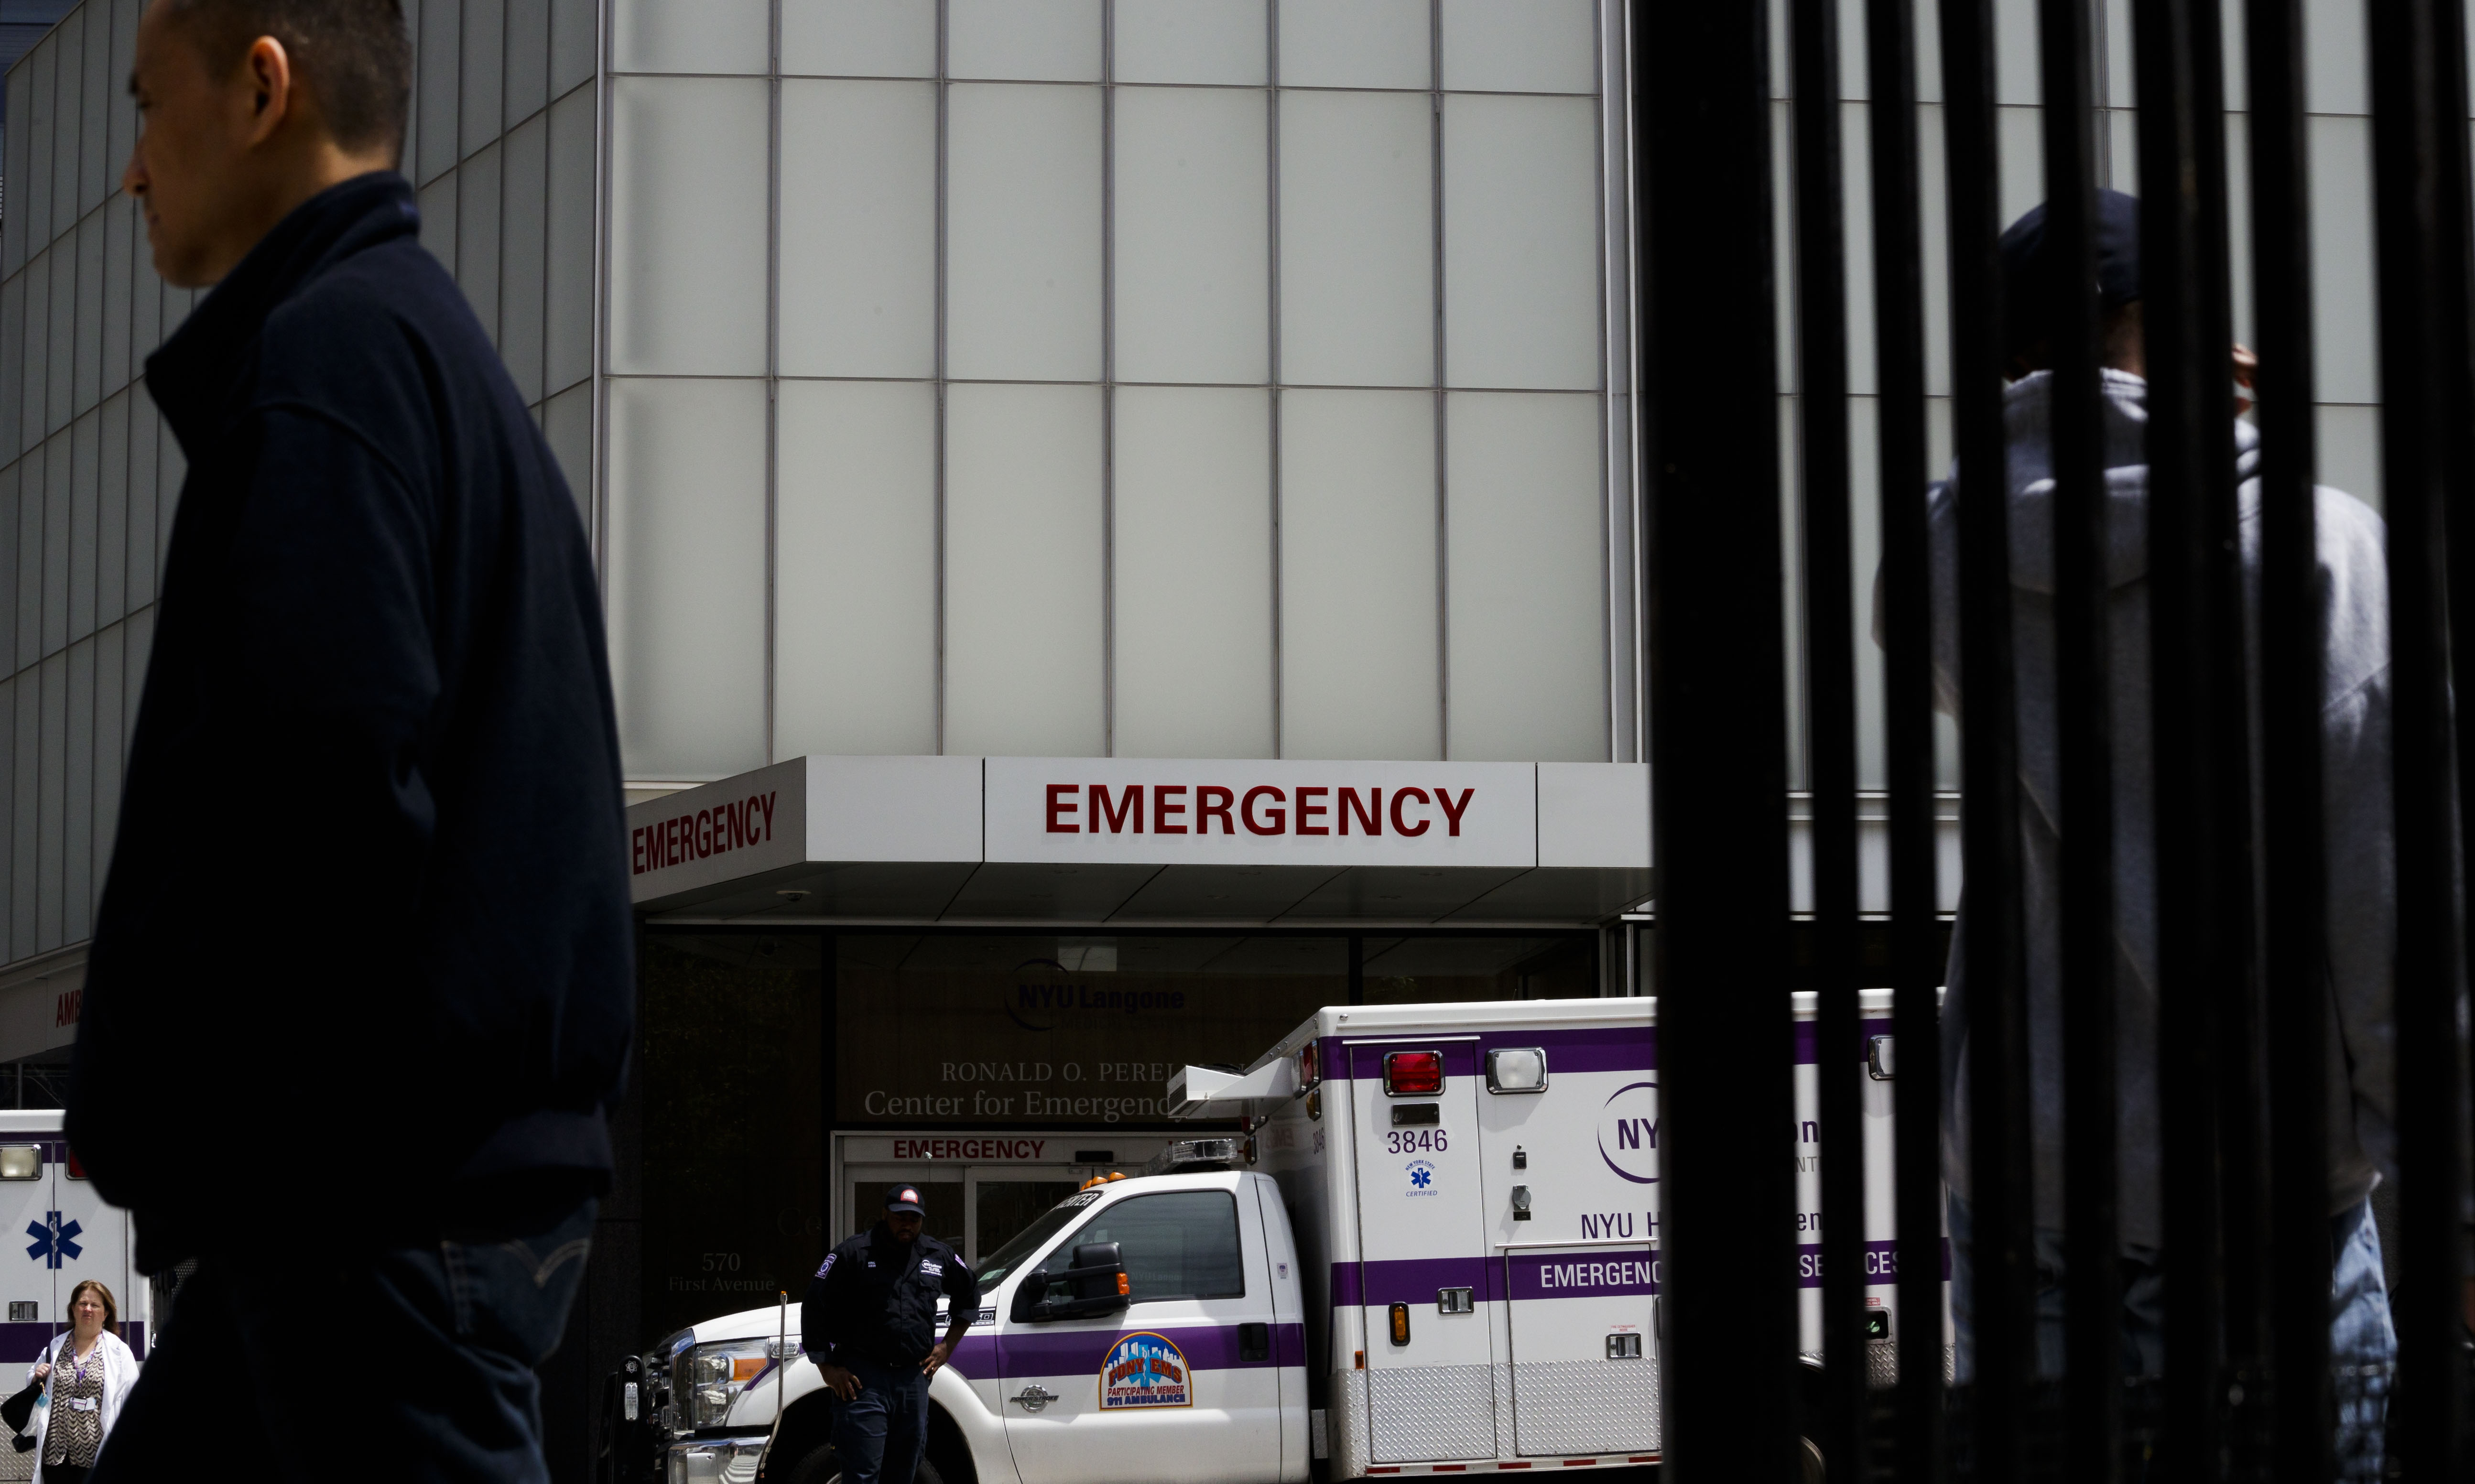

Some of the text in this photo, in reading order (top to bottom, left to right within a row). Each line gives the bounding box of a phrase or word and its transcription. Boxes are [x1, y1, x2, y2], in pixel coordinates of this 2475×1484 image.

[1046, 784, 1476, 837] EMERGENCY
[632, 791, 776, 875] EMERGENCY
[1019, 984, 1185, 1014] NYU Langone
[941, 1062, 1053, 1082] RONALD
[1063, 1062, 1087, 1082] O.
[865, 1090, 1181, 1123] Center for Emergenc
[1313, 1127, 1325, 1155] 3846
[1387, 1129, 1448, 1154] 3846
[1617, 1118, 1660, 1149] NY
[894, 1140, 1045, 1159] EMERGENCY
[1405, 1162, 1413, 1171] NEW
[1424, 1160, 1435, 1170] STATE
[1581, 1213, 1633, 1239] NYU
[702, 1252, 741, 1271] 570
[1541, 1260, 1663, 1288] EMERGENC
[669, 1276, 775, 1291] First Avenue
[1108, 1357, 1183, 1387] FDNY EMS
[1107, 1385, 1184, 1397] PARTICIPATING MEMBER
[1107, 1393, 1185, 1406] 911 AMBULANCE
